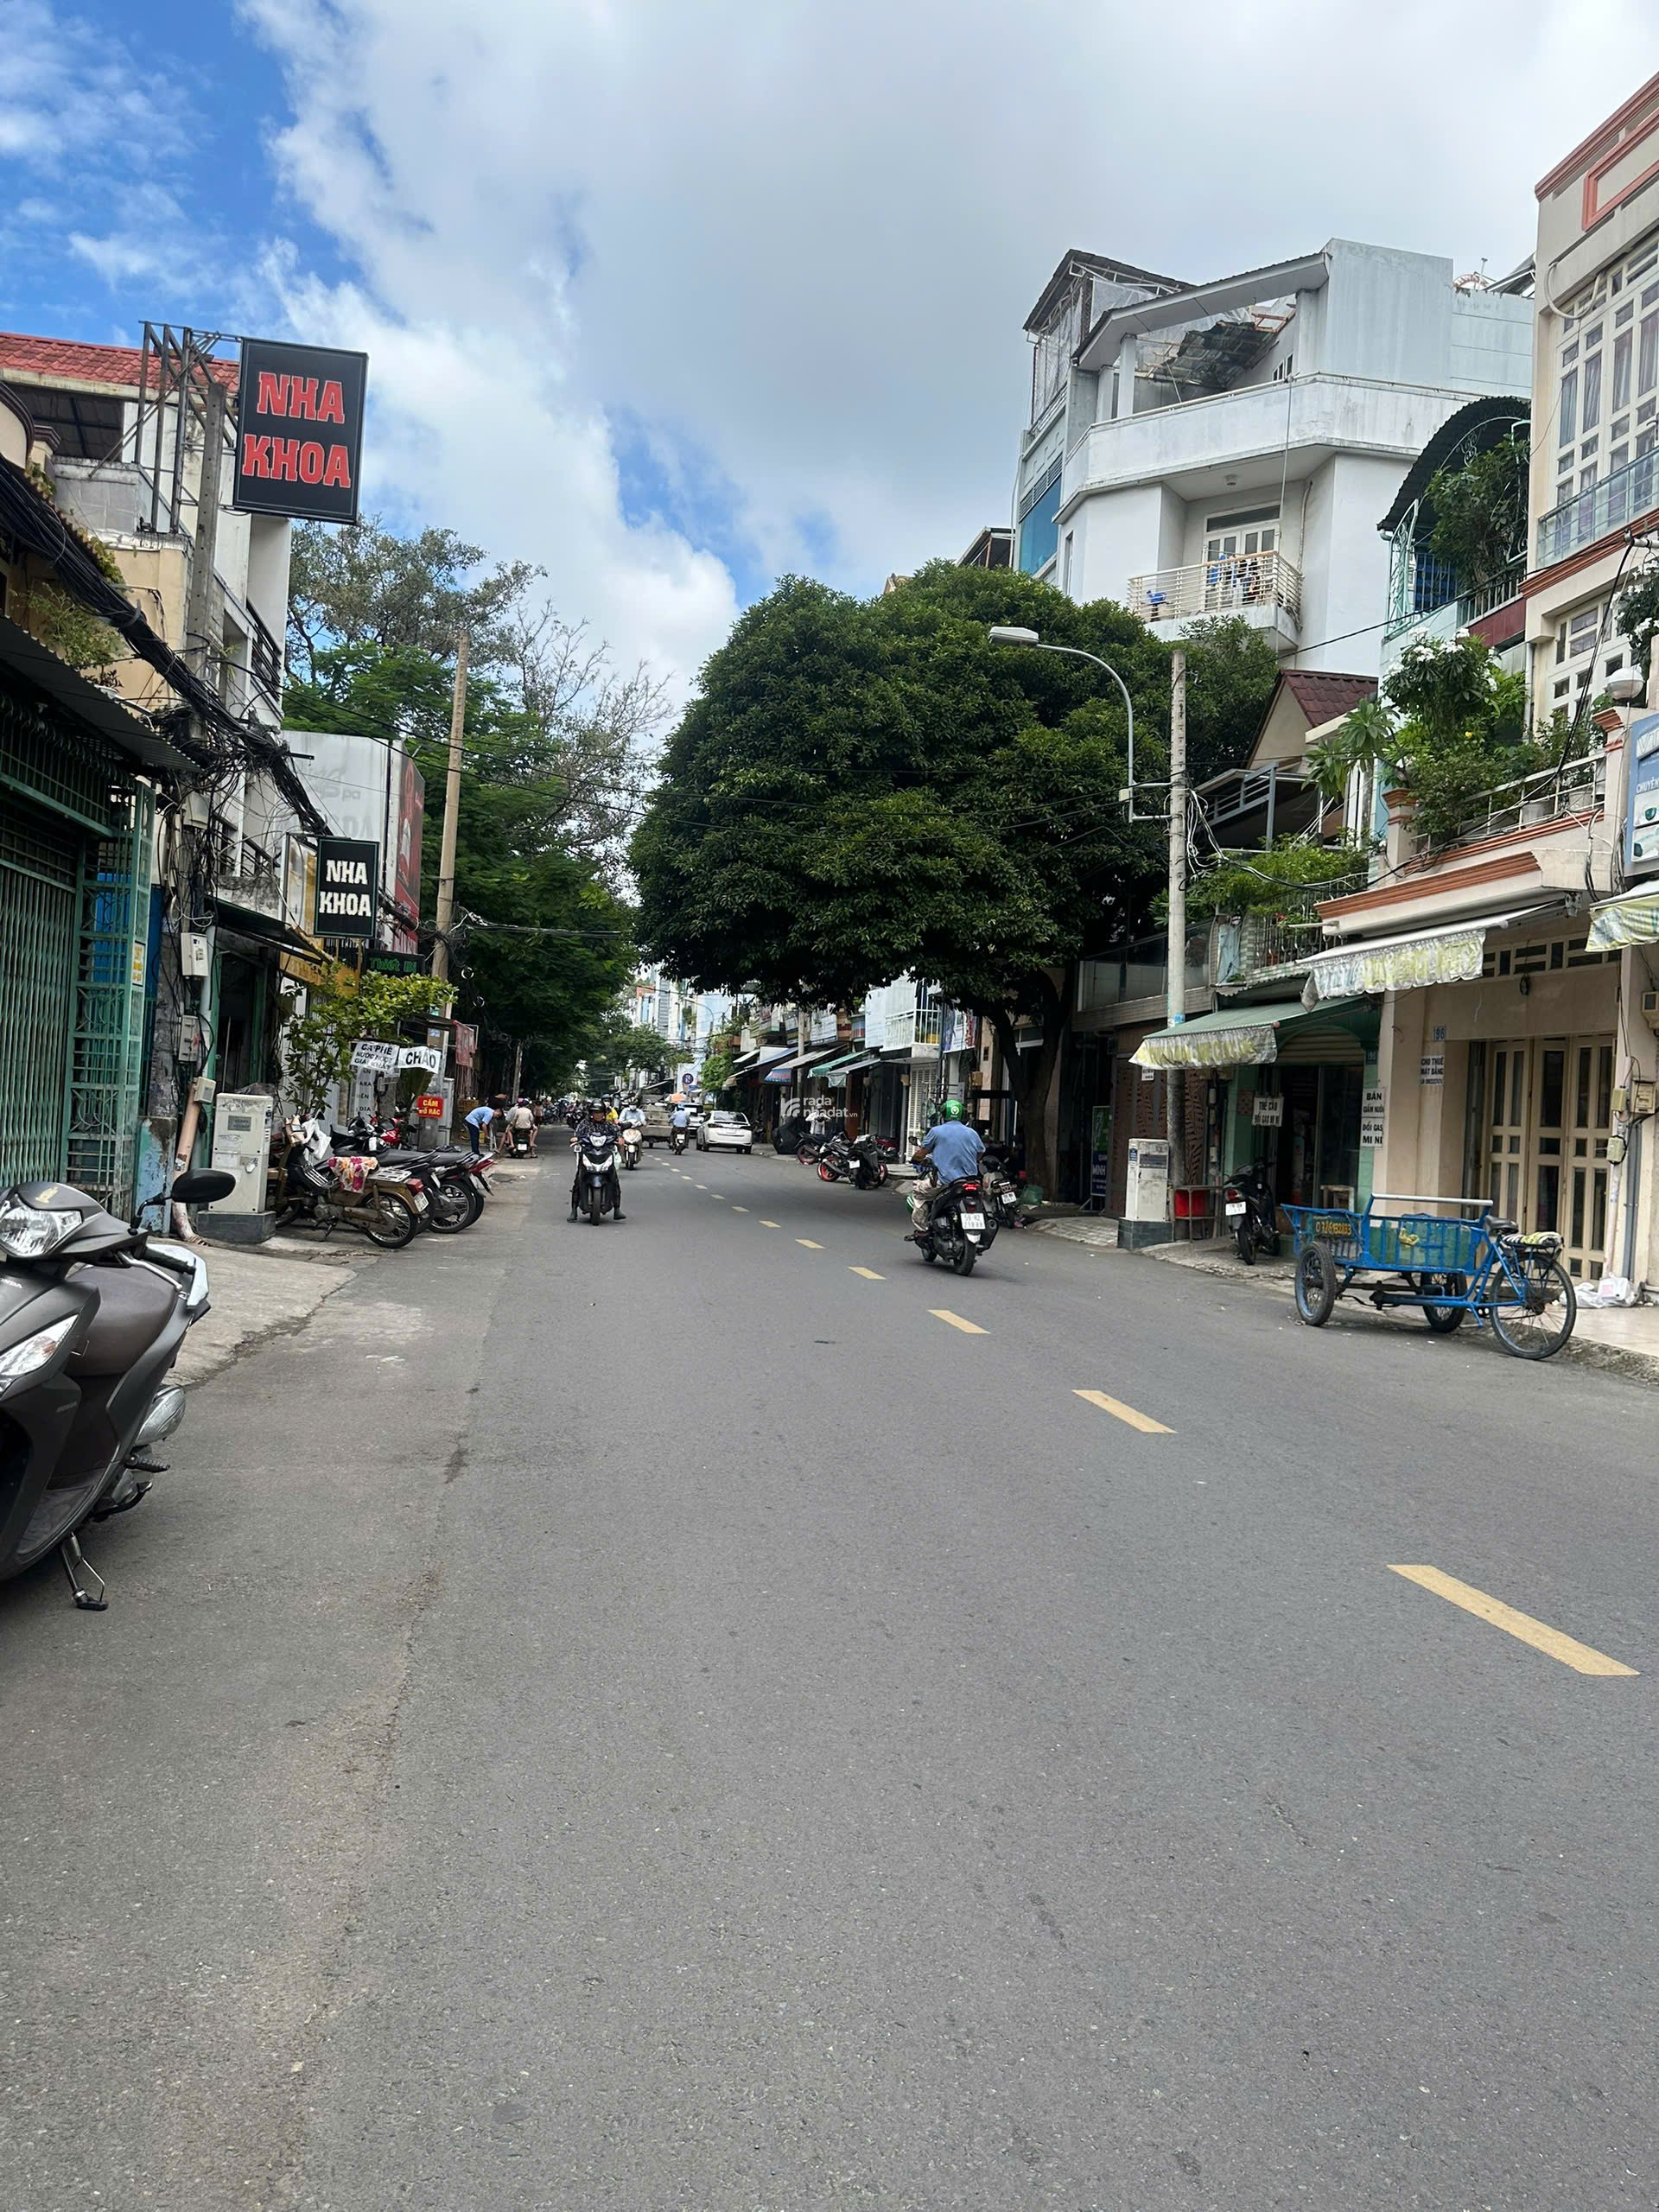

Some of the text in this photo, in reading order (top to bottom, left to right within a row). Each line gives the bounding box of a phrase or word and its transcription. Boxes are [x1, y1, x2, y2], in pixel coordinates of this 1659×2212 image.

[257, 372, 345, 424] NHA
[242, 434, 351, 489] KHOA
[326, 859, 368, 886] NHA
[319, 891, 372, 918] KHOA
